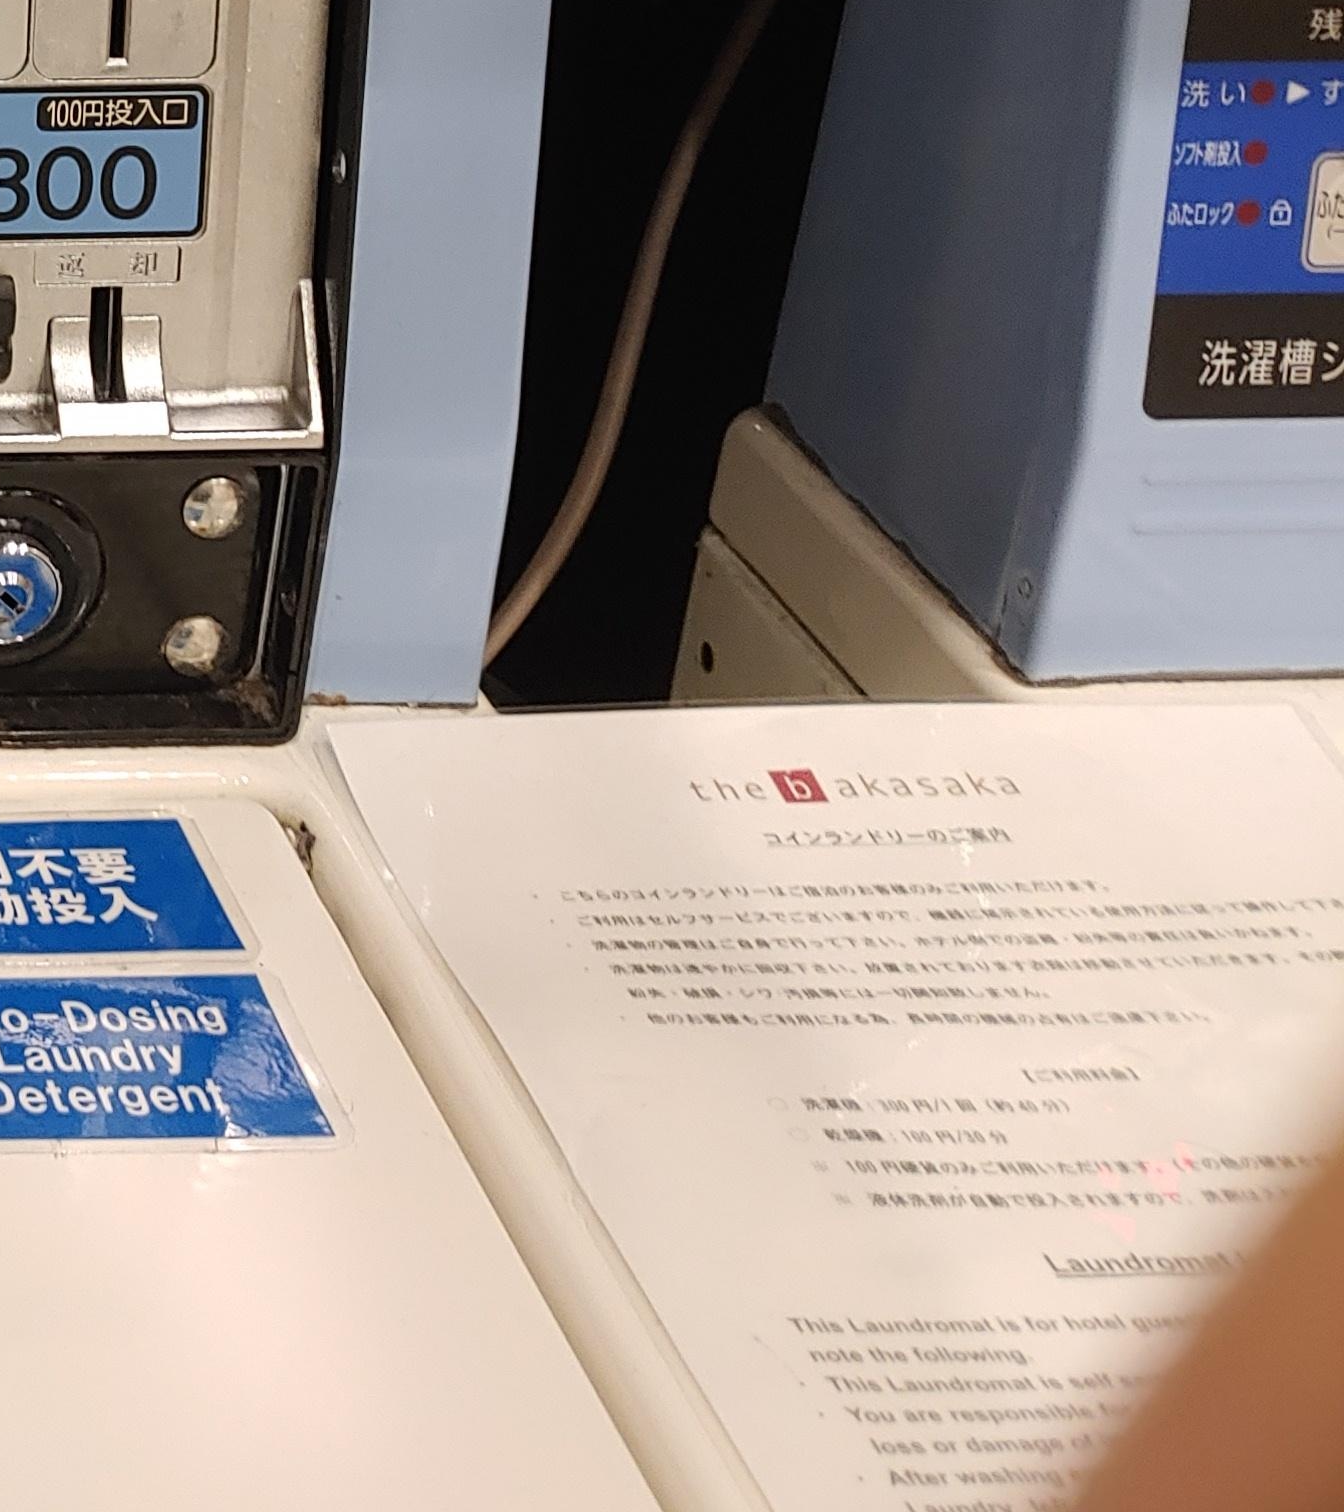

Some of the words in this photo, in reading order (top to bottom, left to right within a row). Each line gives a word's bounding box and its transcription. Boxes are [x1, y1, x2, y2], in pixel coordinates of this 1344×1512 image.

[46, 100, 189, 128] 100円投入口
[1174, 141, 1241, 165] ソフト剤投入
[1167, 202, 1234, 225] ふたロック
[690, 778, 767, 803] the
[835, 771, 1021, 799] akasaka
[1043, 1252, 1230, 1276] Laundromat
[787, 1316, 844, 1335] This
[847, 1316, 995, 1335] Laundromat
[999, 1316, 1021, 1332] is
[1025, 1315, 1059, 1332] for
[1065, 1313, 1126, 1331] hotel
[808, 1348, 864, 1364] note
[868, 1346, 908, 1363] the
[824, 1375, 882, 1394] This
[886, 1375, 1037, 1393] Laundromat
[1041, 1374, 1064, 1391] is
[844, 1406, 896, 1424] You
[903, 1408, 943, 1423] are
[949, 1403, 1093, 1425] responsible
[870, 1437, 927, 1455] loss
[932, 1440, 958, 1454] or
[965, 1436, 1064, 1457] damage
